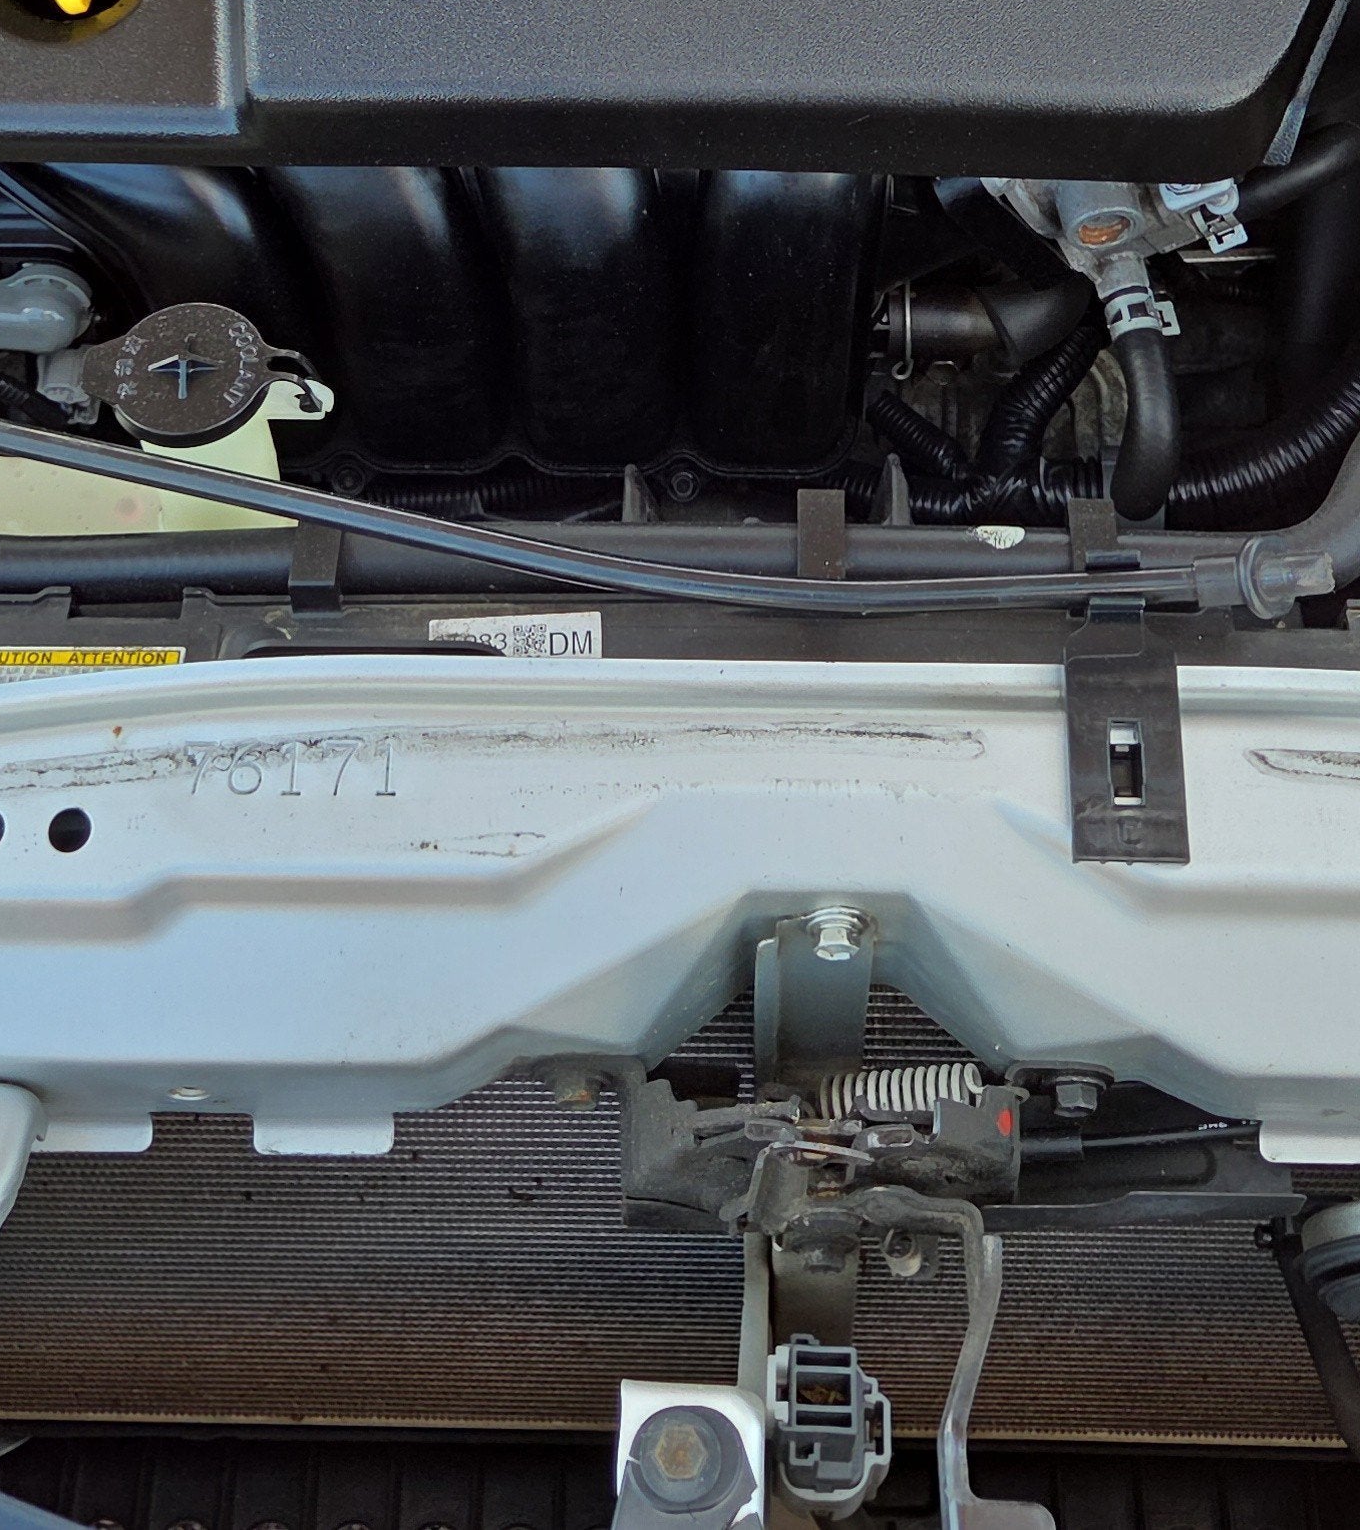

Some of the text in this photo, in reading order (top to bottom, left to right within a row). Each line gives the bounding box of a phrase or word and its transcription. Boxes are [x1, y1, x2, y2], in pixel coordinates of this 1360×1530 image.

[223, 321, 260, 410] COOLANT
[549, 630, 593, 656] DM
[69, 651, 168, 664] ATTENTION
